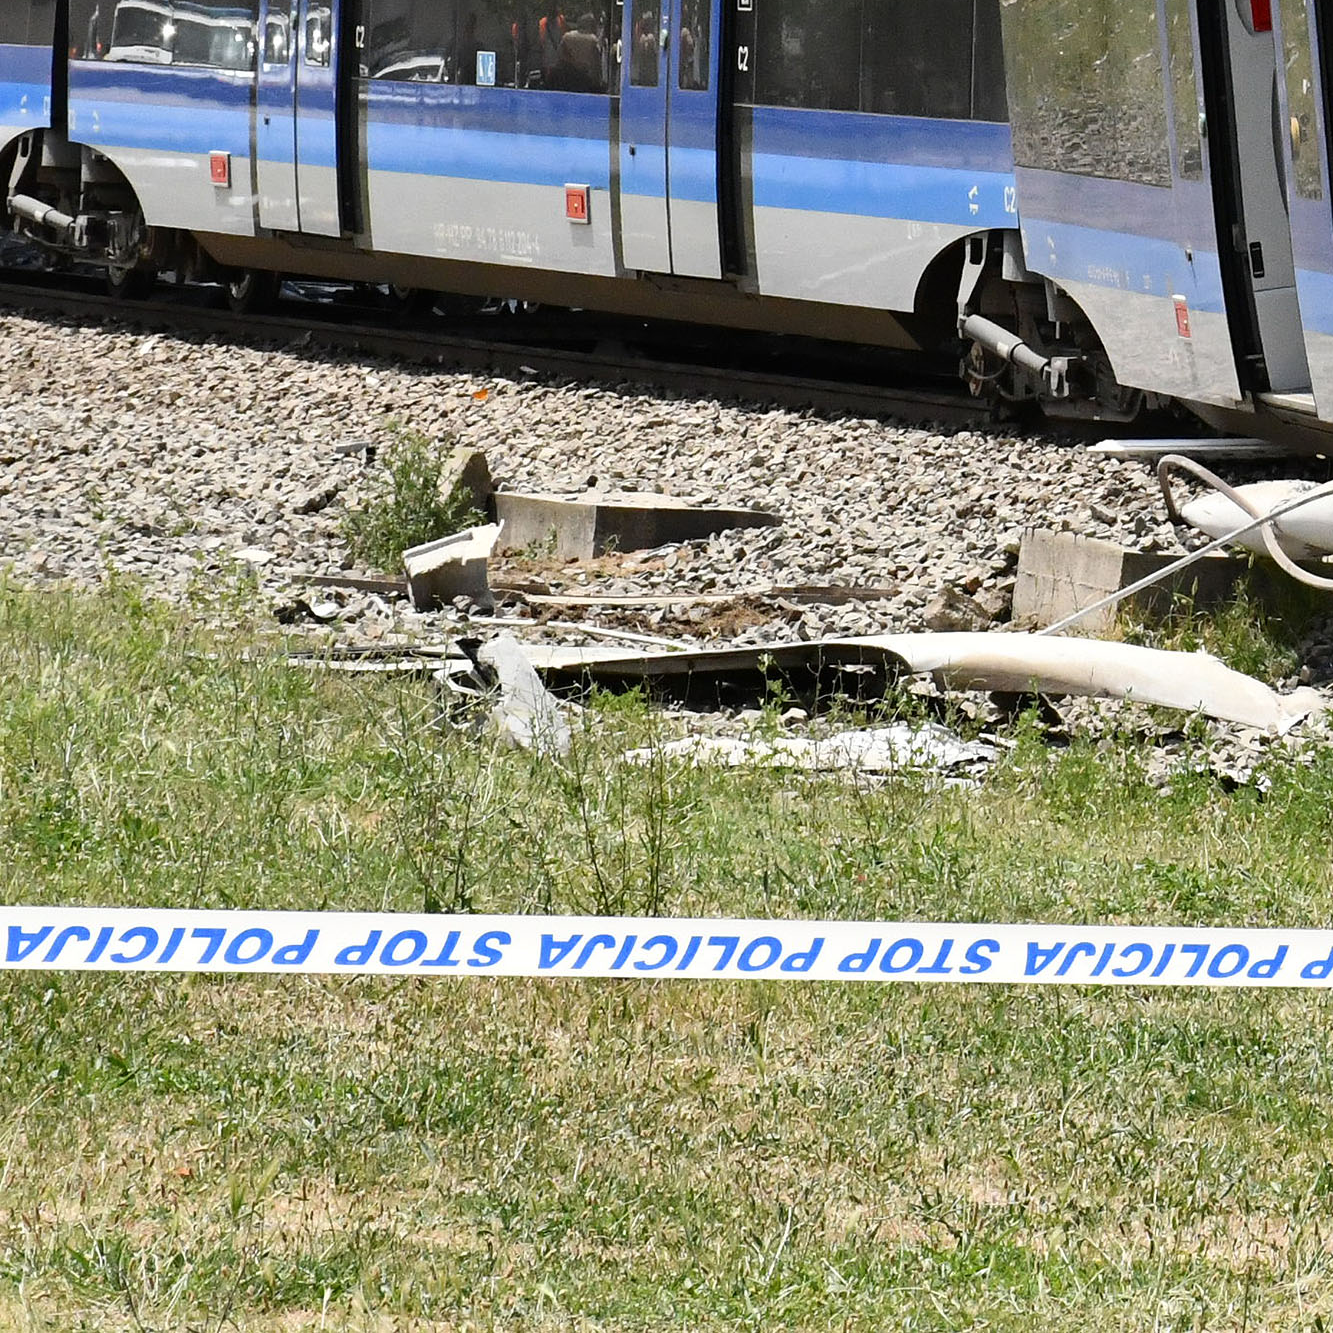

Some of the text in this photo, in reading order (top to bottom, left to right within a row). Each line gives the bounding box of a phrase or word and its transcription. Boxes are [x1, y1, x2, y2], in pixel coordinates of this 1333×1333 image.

[738, 45, 748, 71] C2
[1004, 186, 1016, 214] C2
[6, 926, 320, 965] POLICIJA
[335, 930, 511, 967] STOP
[539, 934, 824, 972] POLICIJA
[838, 938, 1000, 974] STOP
[1025, 942, 1288, 978] POLICIJA
